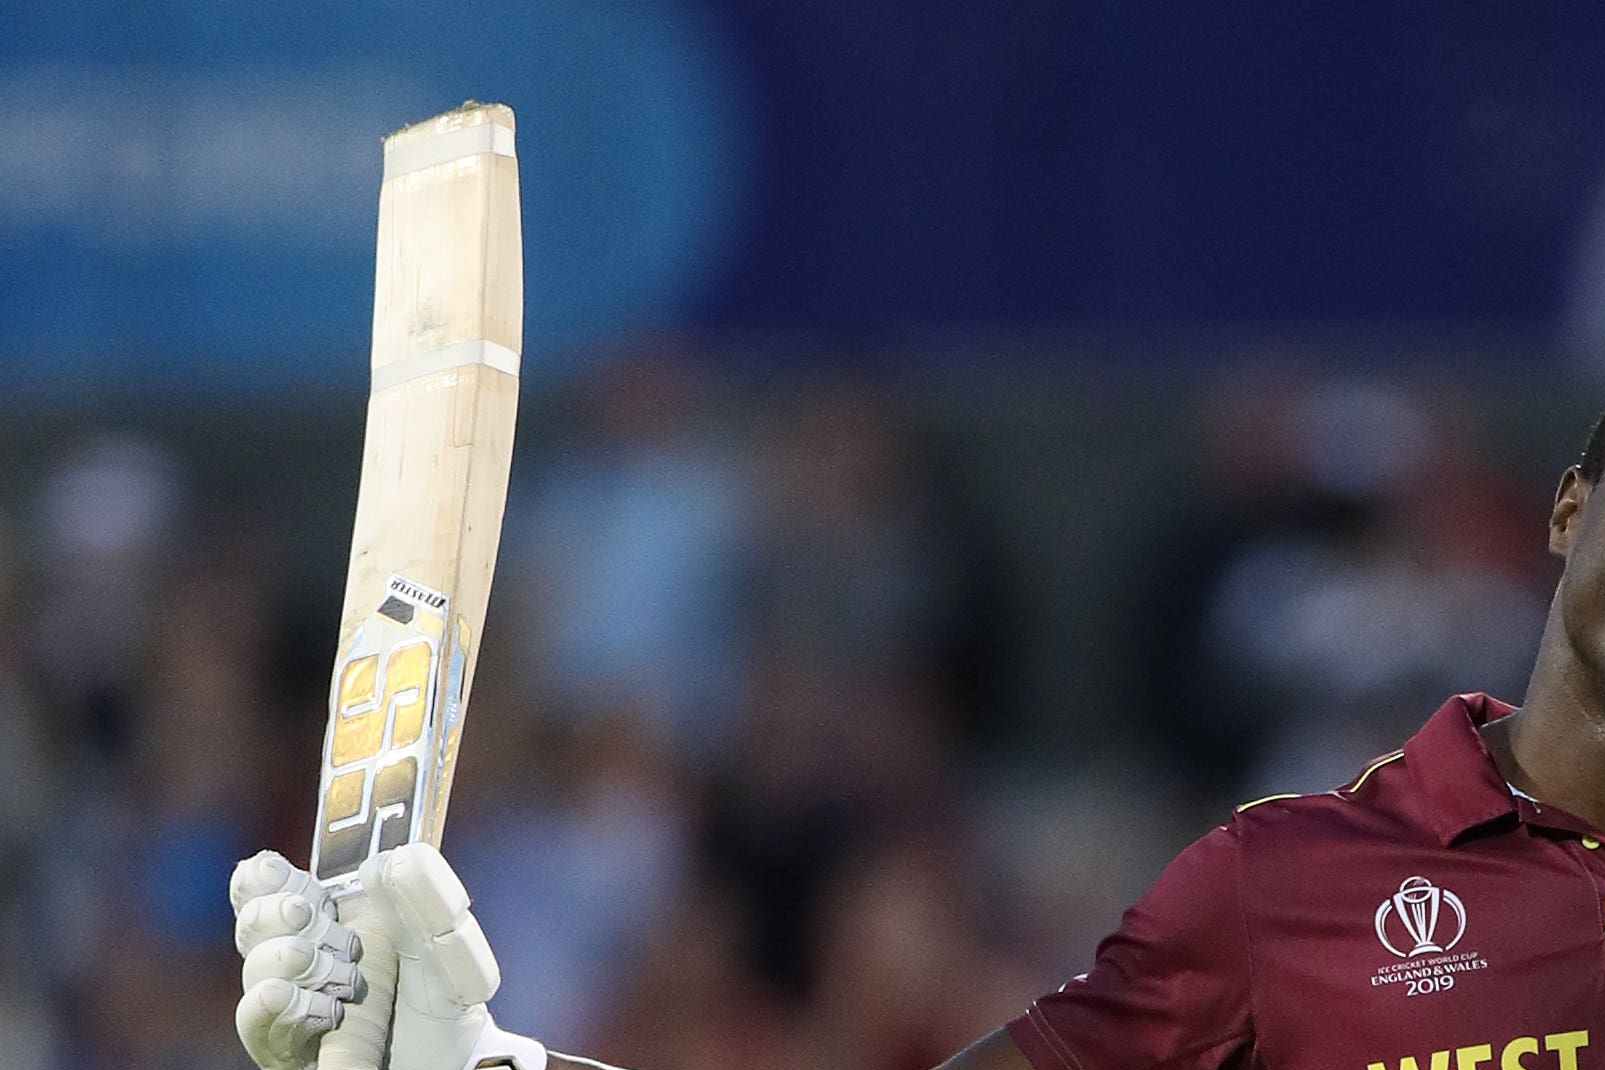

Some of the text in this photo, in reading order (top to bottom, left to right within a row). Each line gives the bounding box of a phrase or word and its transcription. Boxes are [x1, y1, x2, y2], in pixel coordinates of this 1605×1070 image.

[1371, 967, 1432, 986] ENGLAND
[1443, 958, 1488, 974] WALES
[1377, 951, 1478, 975] ICC CRICKET WORLD CUP
[1405, 975, 1454, 997] 2019
